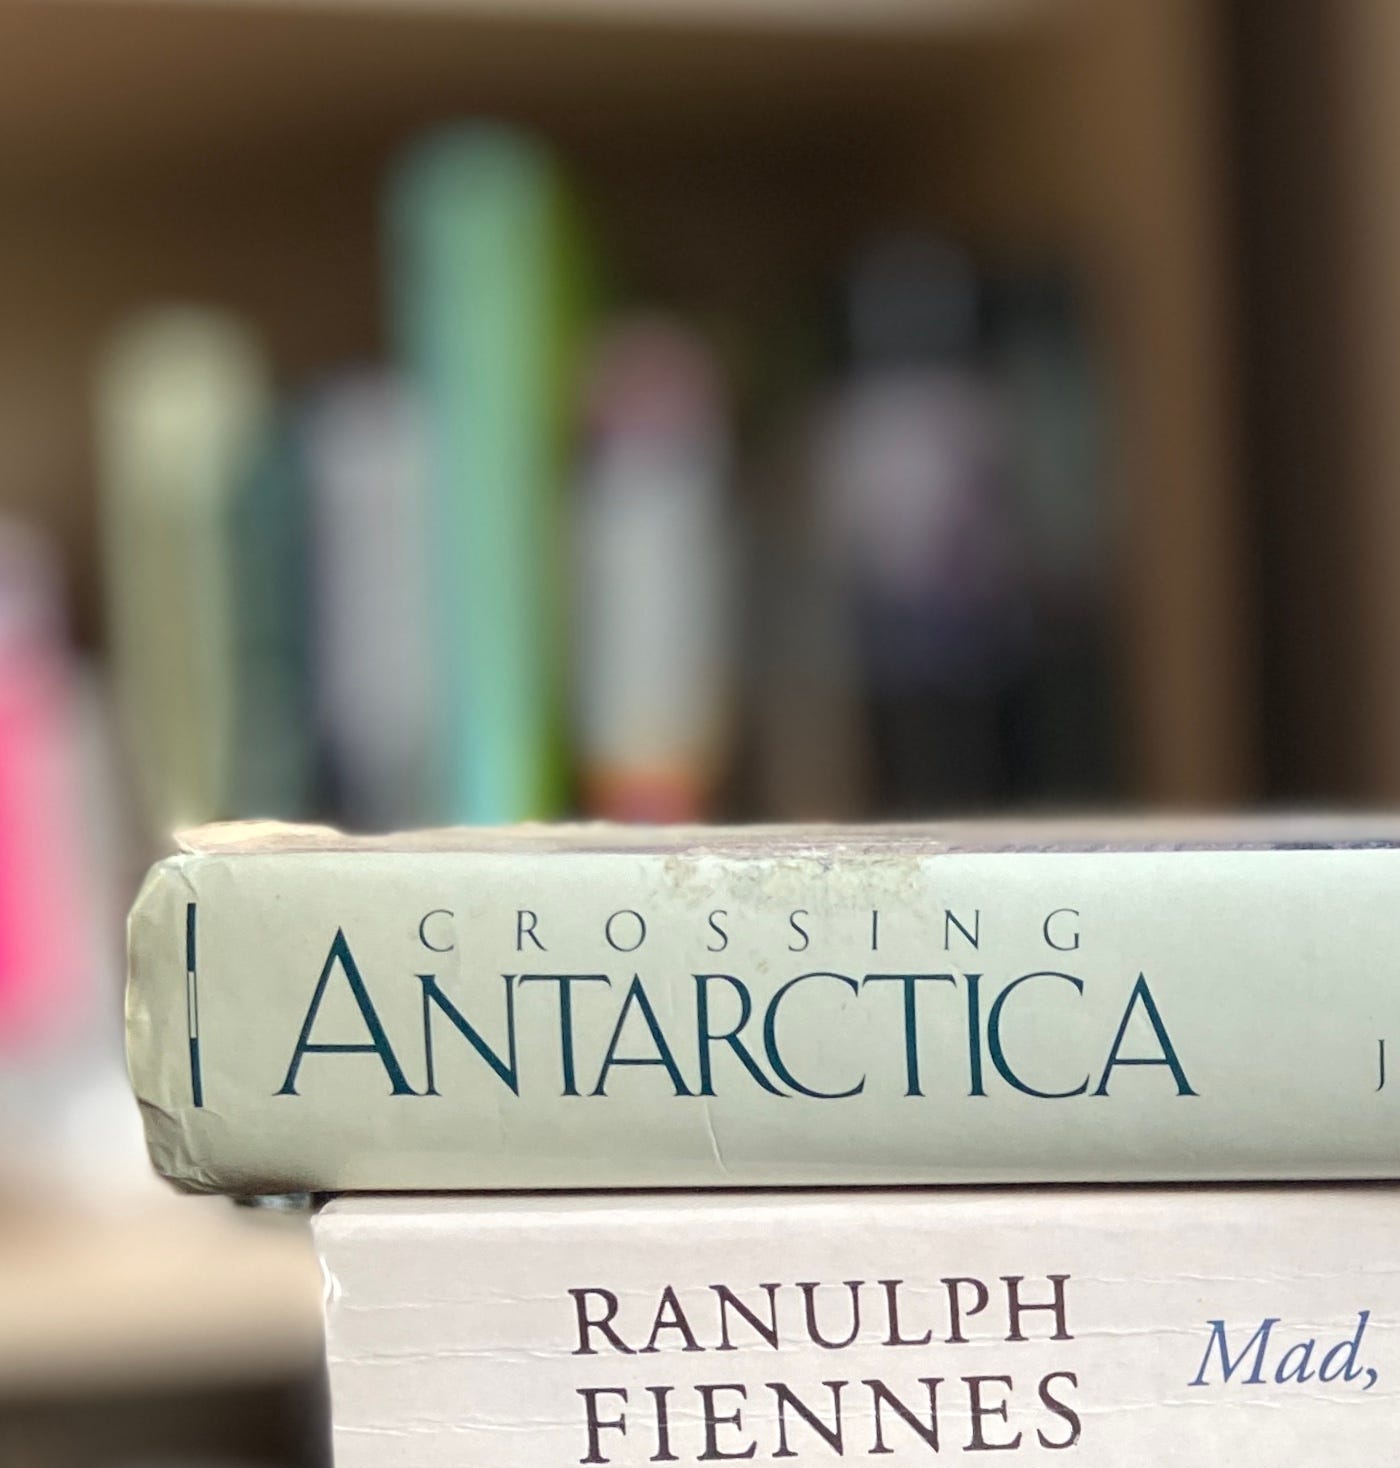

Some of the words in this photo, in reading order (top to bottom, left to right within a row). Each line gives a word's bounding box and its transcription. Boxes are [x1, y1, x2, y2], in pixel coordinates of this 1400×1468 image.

[419, 909, 1079, 952] CROSSING
[273, 926, 1199, 1099] ANTARCTICA
[568, 1275, 1074, 1355] RANULPH
[1188, 1310, 1377, 1390] Mad,
[576, 1372, 1081, 1464] FIENNES
